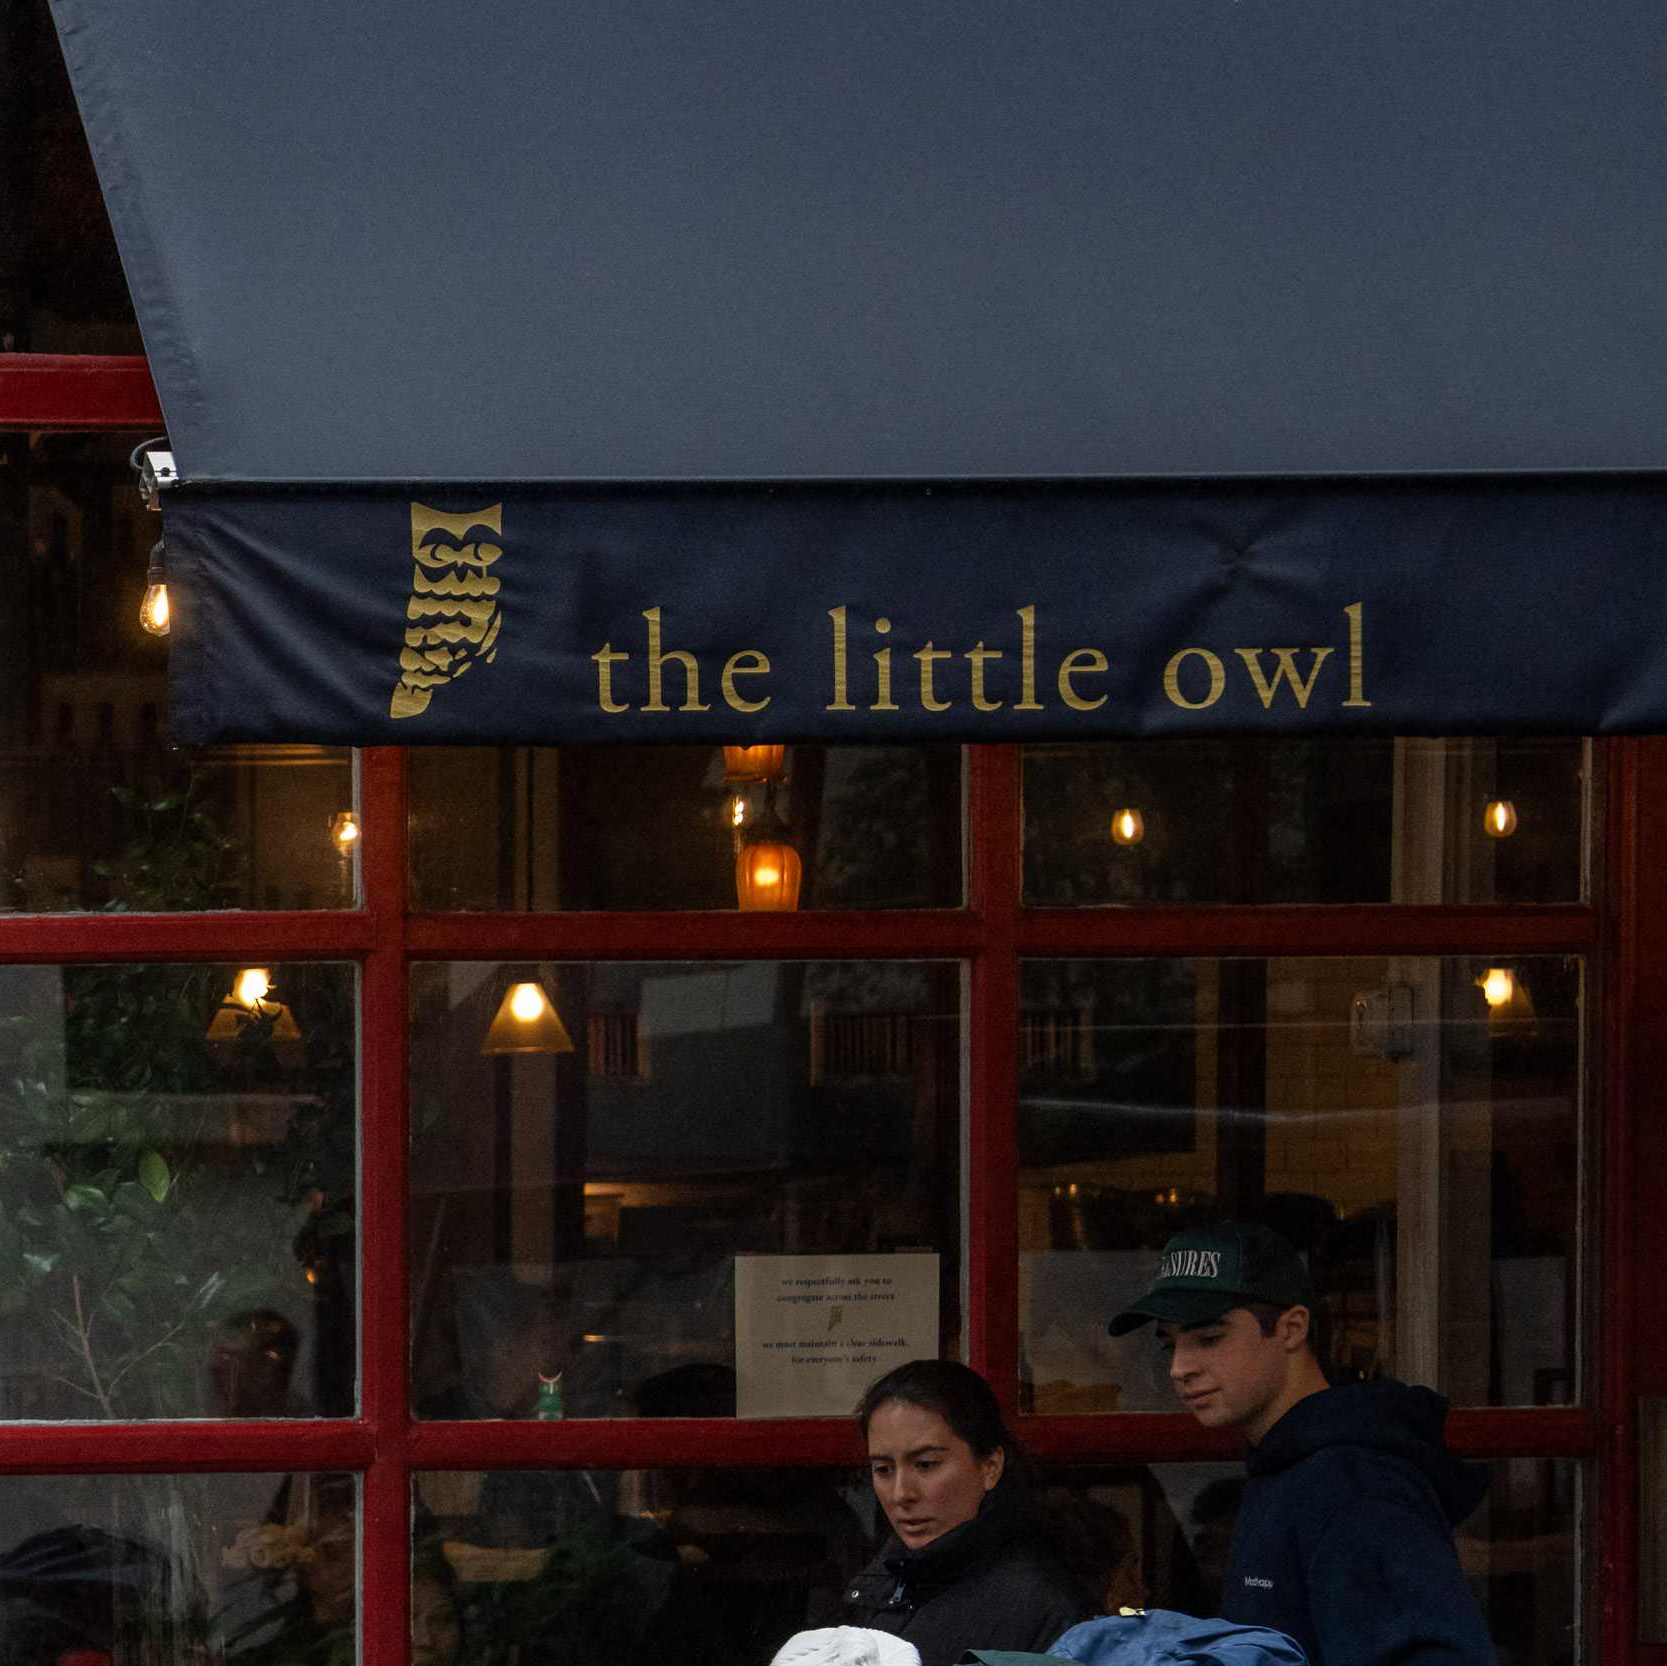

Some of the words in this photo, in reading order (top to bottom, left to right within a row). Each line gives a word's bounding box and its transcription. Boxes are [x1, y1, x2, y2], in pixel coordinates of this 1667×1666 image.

[591, 608, 771, 714] the
[827, 604, 1108, 712] little
[1163, 602, 1371, 710] owl
[795, 1276, 845, 1288] respectfully
[847, 1276, 861, 1286] ask
[864, 1278, 880, 1288] you
[882, 1277, 892, 1286] to
[778, 1293, 823, 1304] congregate
[854, 1292, 869, 1301] the
[775, 1341, 796, 1349] must
[798, 1338, 837, 1348] maintain
[791, 1354, 803, 1364] for
